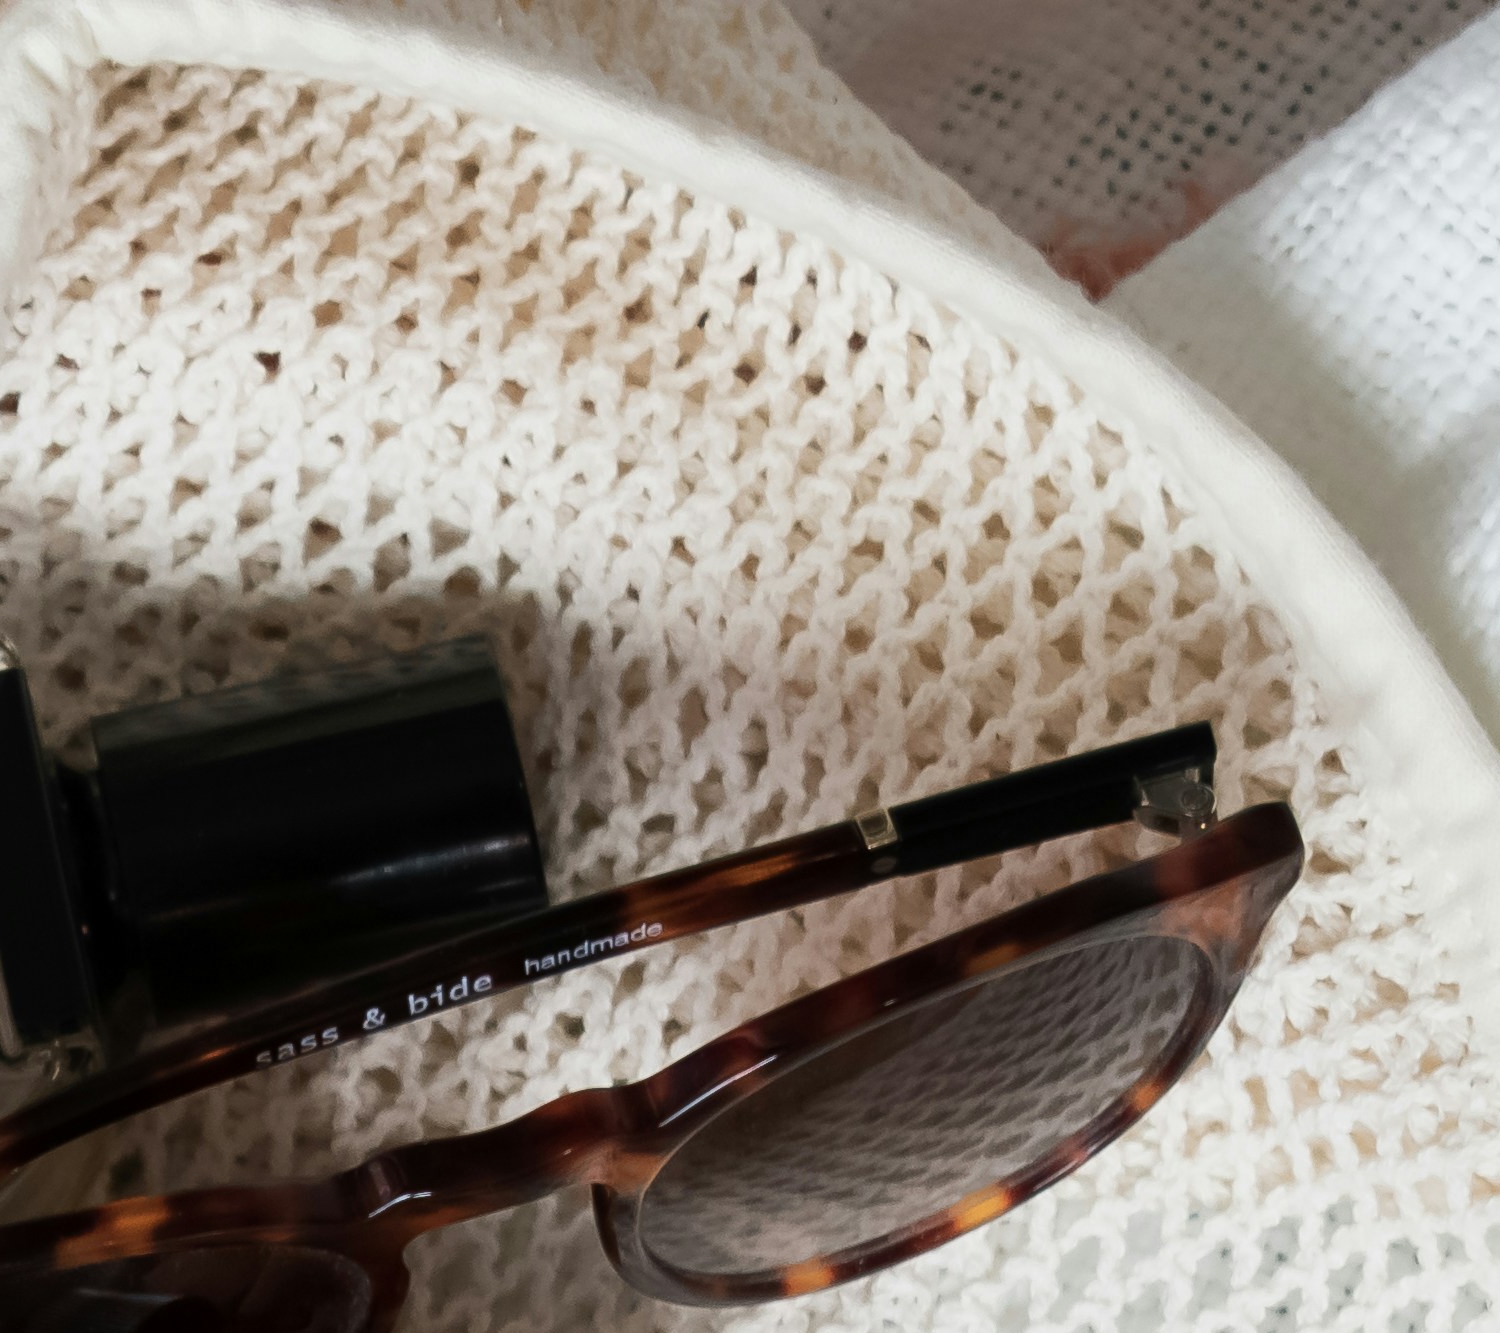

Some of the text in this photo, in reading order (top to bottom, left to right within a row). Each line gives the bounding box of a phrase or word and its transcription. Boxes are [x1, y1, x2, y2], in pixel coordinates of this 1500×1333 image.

[255, 919, 665, 1070] sass & bide handmade
